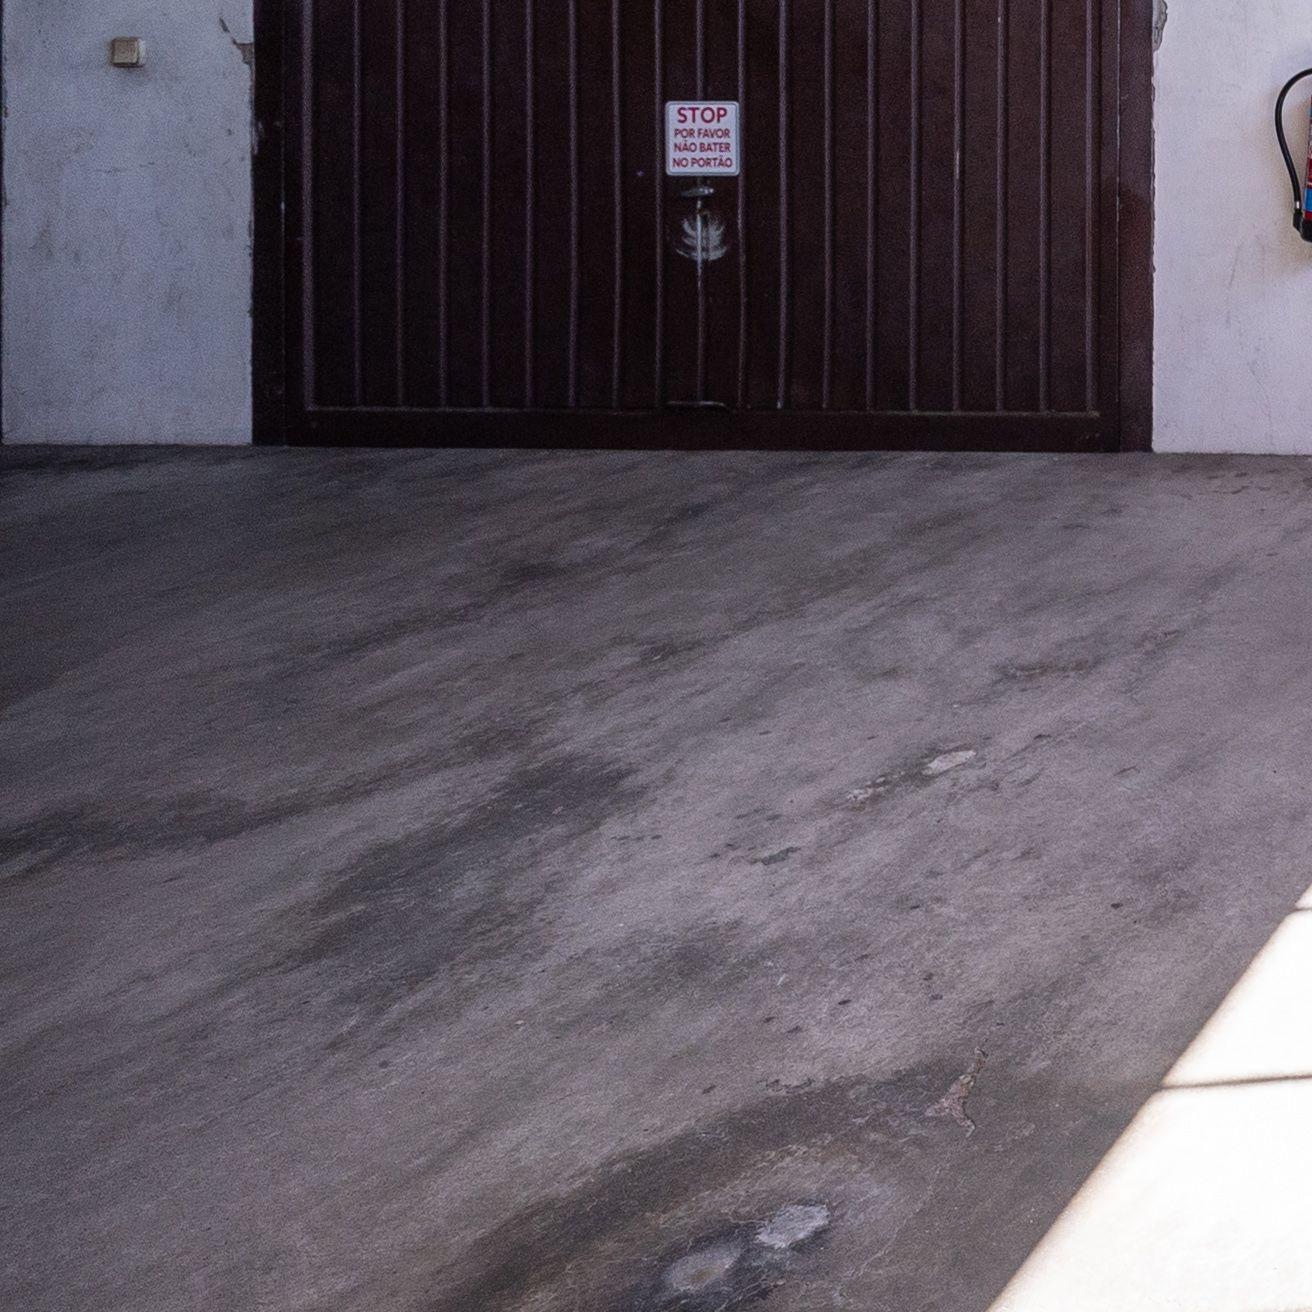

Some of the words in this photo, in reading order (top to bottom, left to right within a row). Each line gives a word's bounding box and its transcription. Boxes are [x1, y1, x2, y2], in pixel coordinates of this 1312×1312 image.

[677, 107, 727, 123] STOP
[674, 128, 695, 138] POR
[697, 128, 731, 138] FAVOR
[674, 139, 697, 152] NÃO
[699, 142, 731, 152] BATER
[672, 157, 689, 167] NO
[690, 155, 733, 167] PORTÃO
